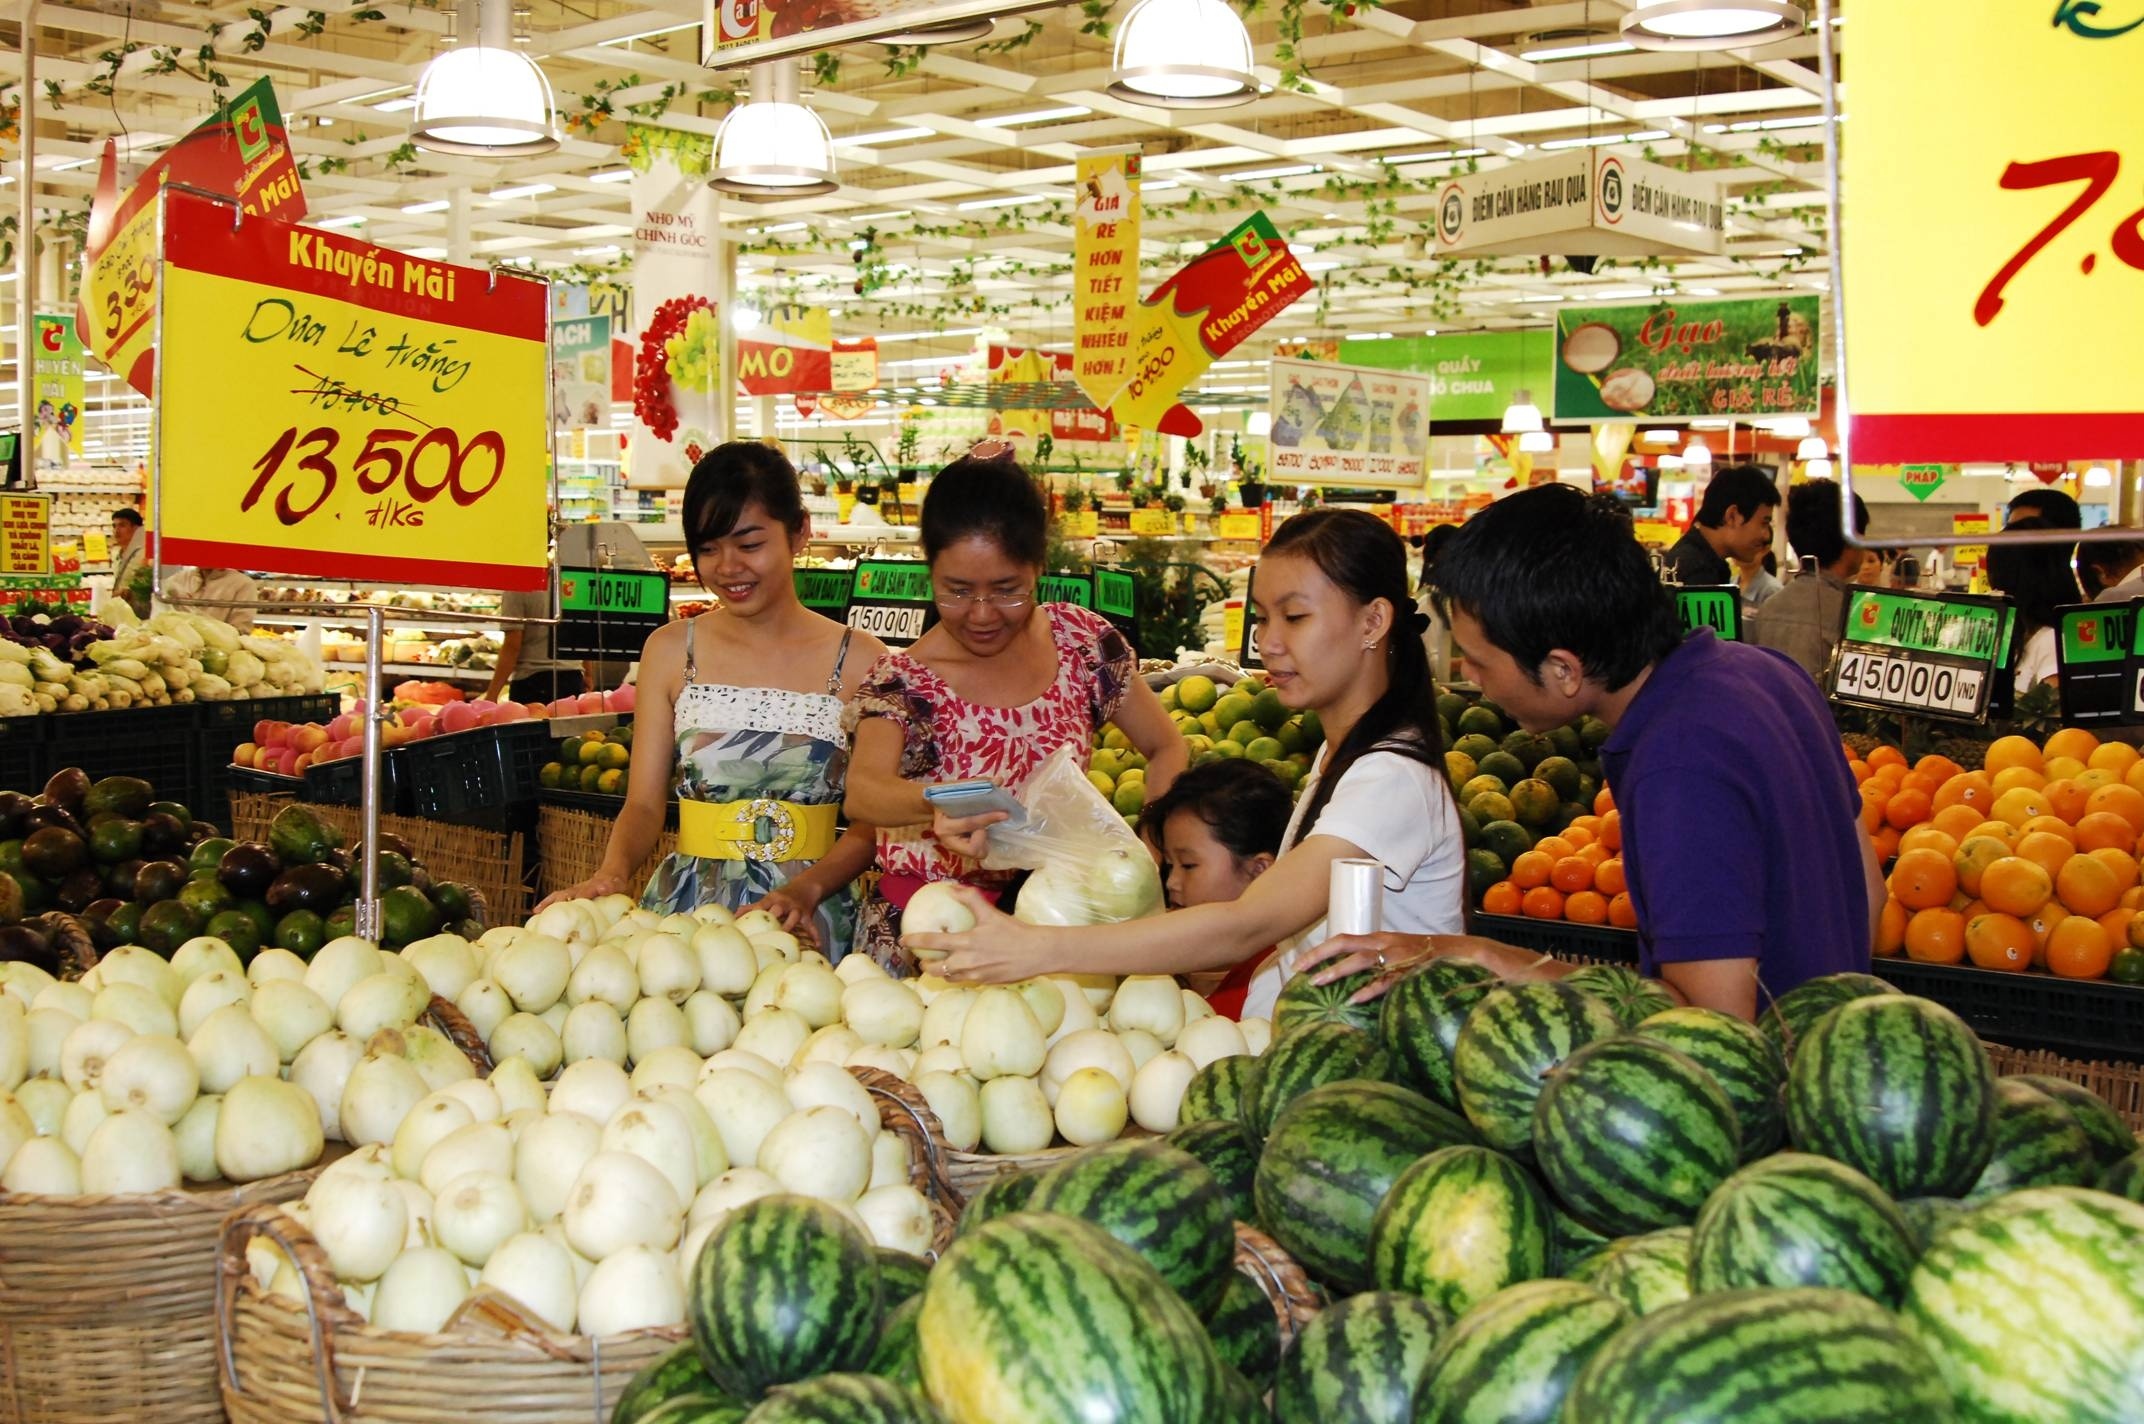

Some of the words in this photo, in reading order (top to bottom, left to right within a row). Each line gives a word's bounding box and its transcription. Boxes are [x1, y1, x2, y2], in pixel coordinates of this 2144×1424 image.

[1544, 177, 1563, 208] RAU
[646, 211, 673, 226] NHO
[1974, 150, 2144, 326] 7.
[289, 231, 394, 288] Khuyến
[403, 261, 455, 302] Mãi
[1205, 292, 1269, 341] Khuyến
[1267, 261, 1302, 294] Mãi
[337, 320, 377, 356] Lê
[555, 323, 591, 351] ẠCH
[1638, 308, 1726, 355] Gạo
[35, 355, 81, 375] HUYẾN
[1451, 380, 1495, 395] CHUA
[241, 427, 505, 526] 13.500
[1905, 467, 1938, 484] PHÁP
[1841, 658, 1953, 701] 45.000
[1957, 681, 1976, 700] VND
